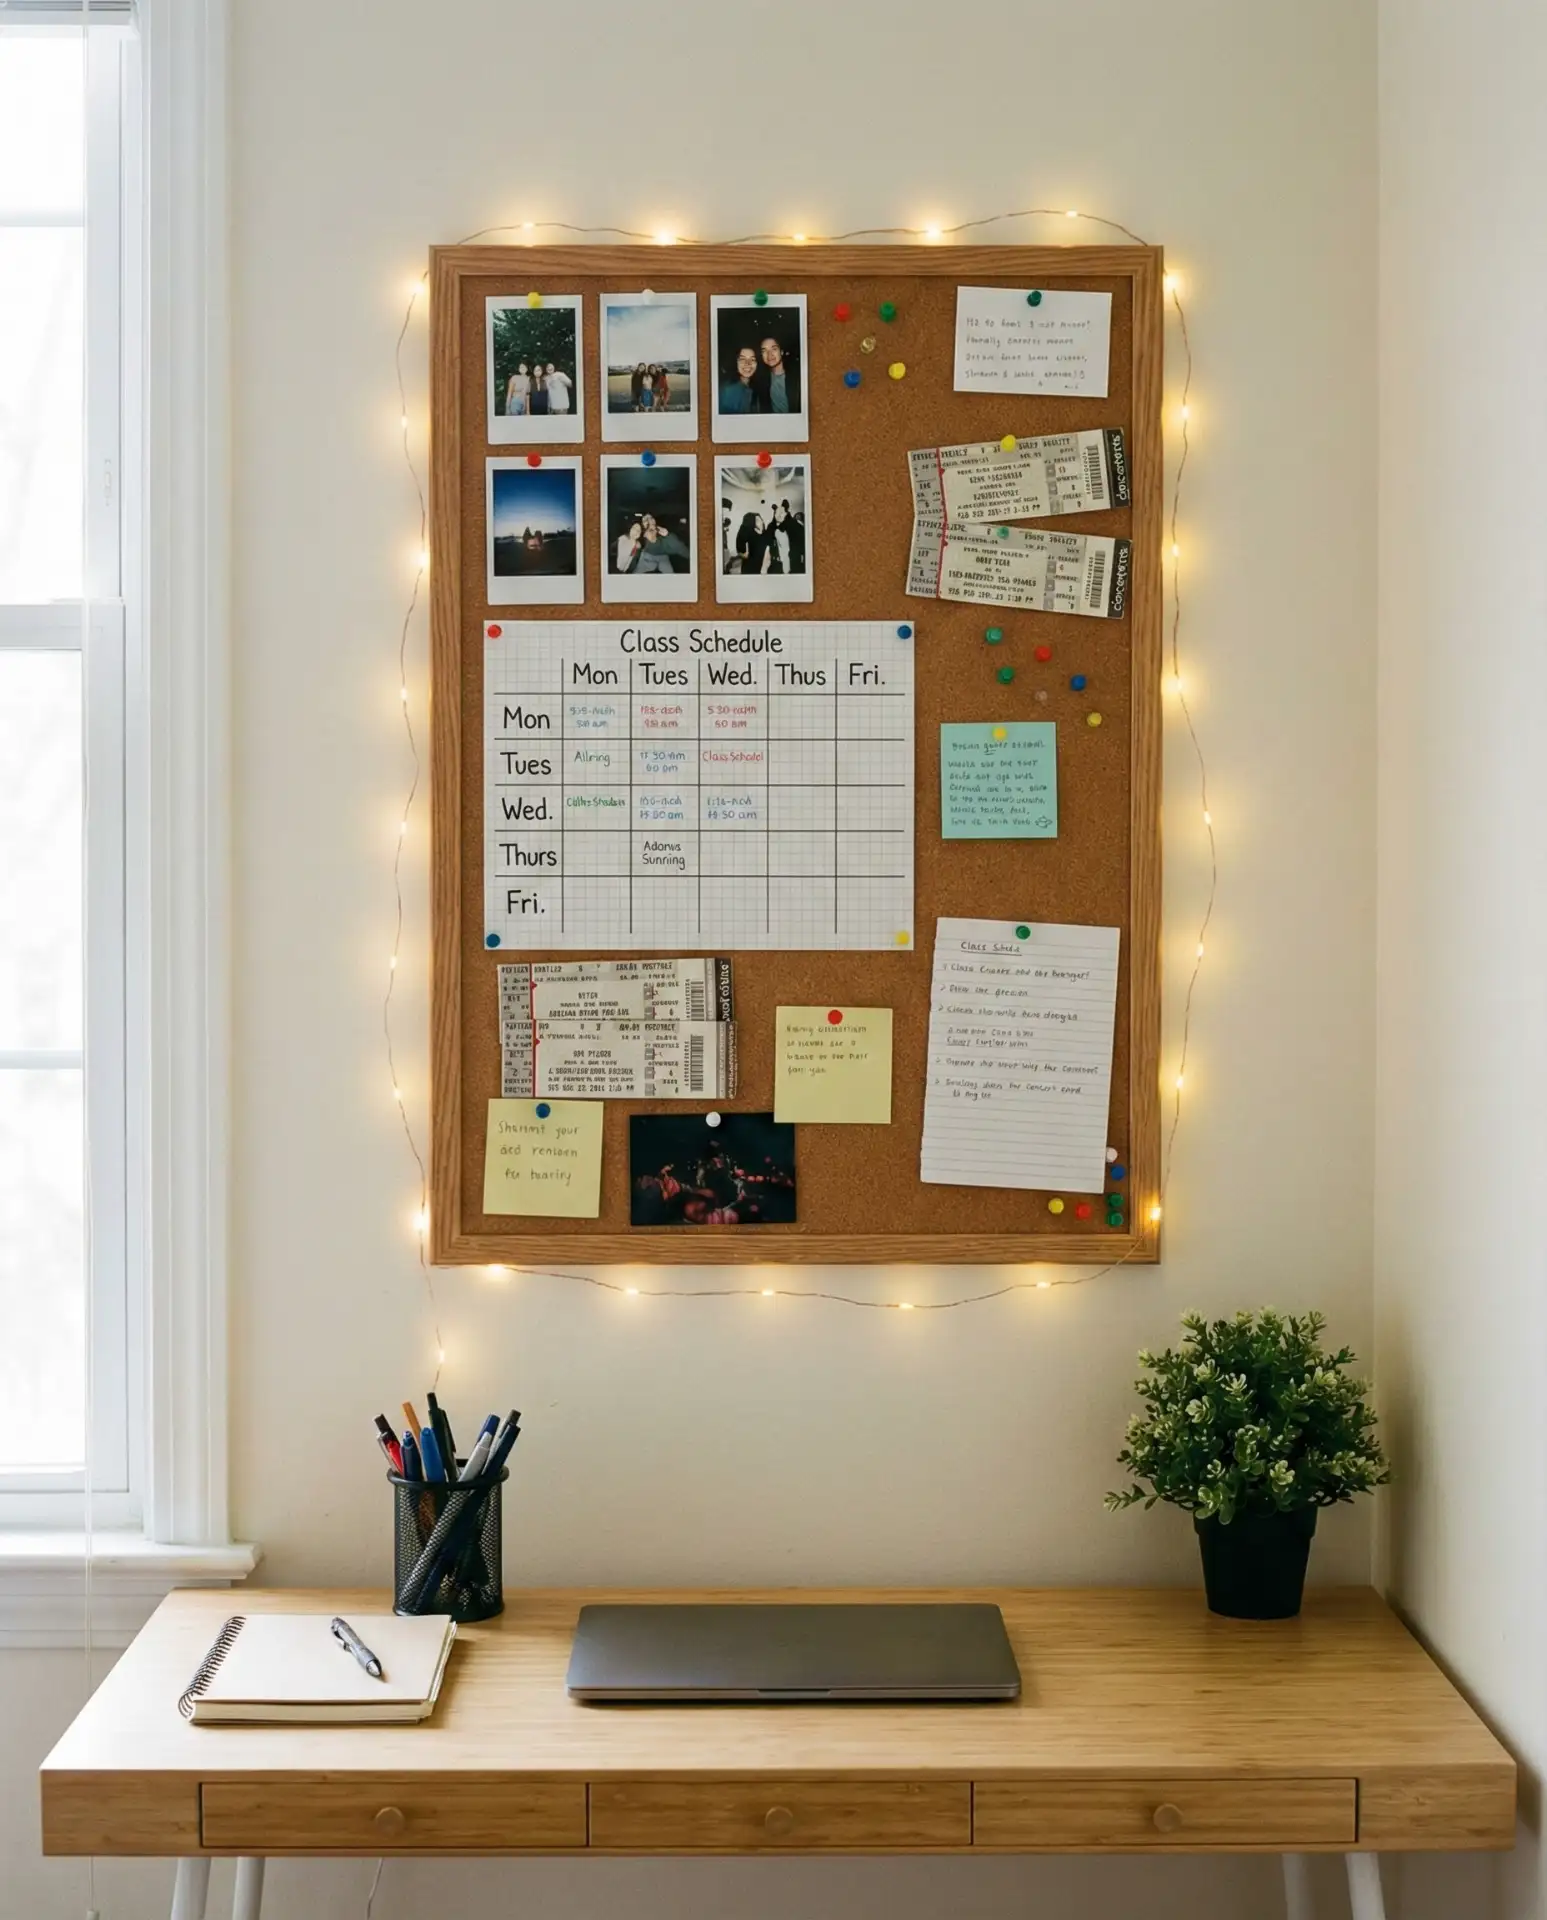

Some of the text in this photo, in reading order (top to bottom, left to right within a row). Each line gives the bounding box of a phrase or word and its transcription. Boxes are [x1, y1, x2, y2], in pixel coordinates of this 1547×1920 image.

[620, 628, 783, 654] Class Schedule
[572, 662, 886, 686] Mon Tues Wed. Thus Fri.
[503, 705, 551, 730] Mon
[499, 751, 552, 776] Tues
[501, 796, 554, 821] Wed.
[498, 843, 558, 867] Thurs
[507, 889, 545, 914] Fri.
